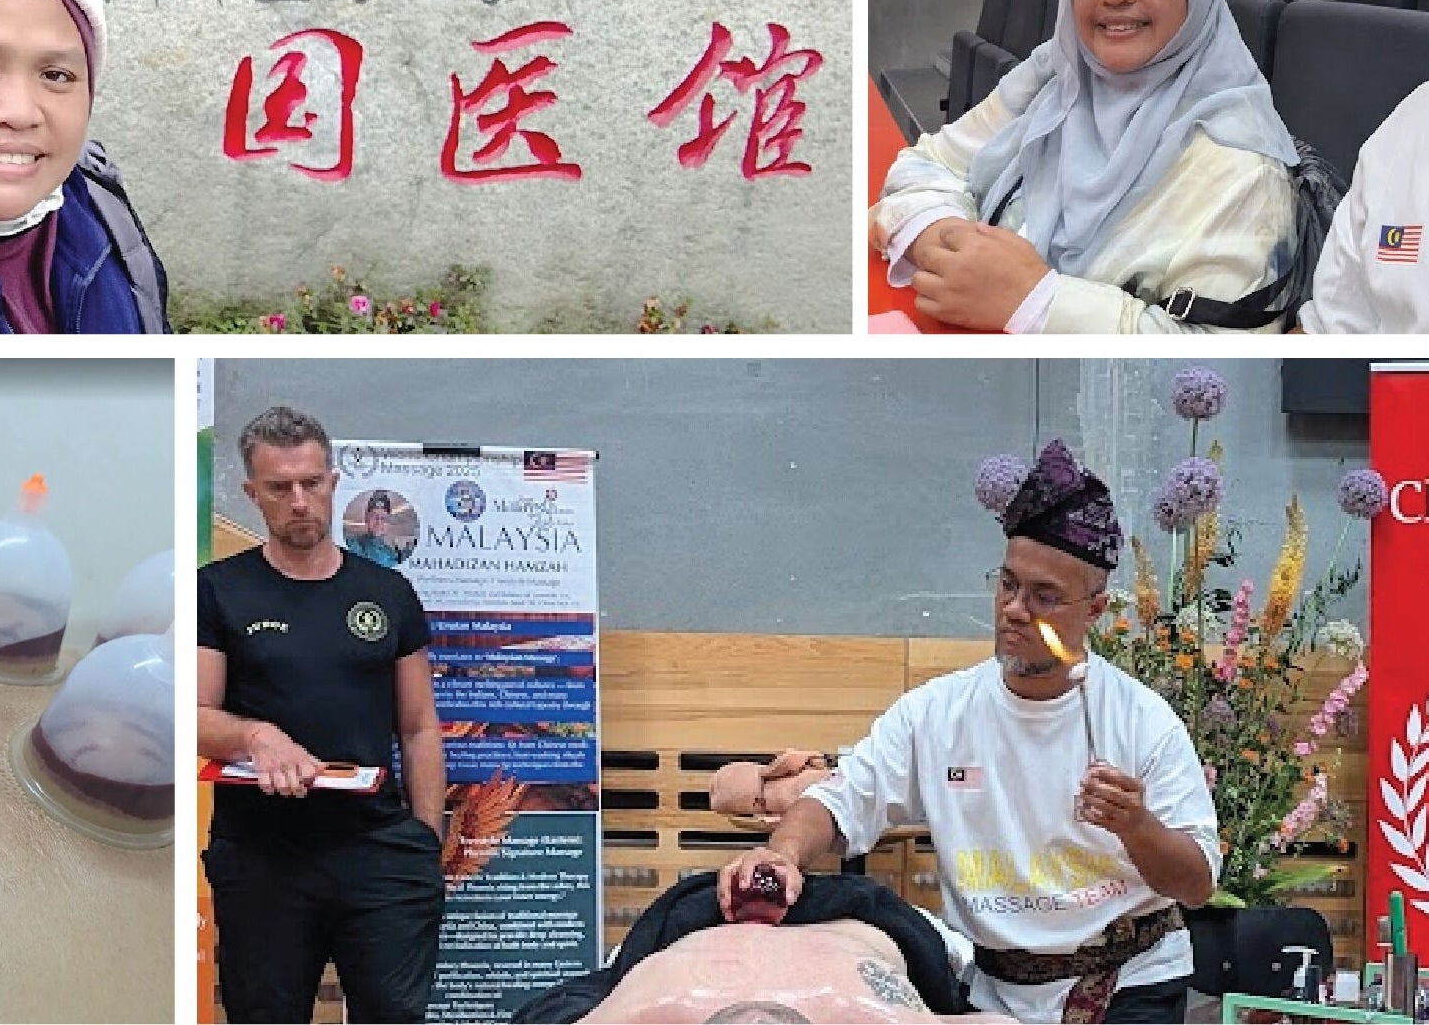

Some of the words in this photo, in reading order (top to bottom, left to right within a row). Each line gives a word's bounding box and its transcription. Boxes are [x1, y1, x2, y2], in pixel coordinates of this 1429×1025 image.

[222, 20, 825, 184] 国医馆
[426, 525, 582, 553] MALAYSIA
[960, 894, 1068, 914] MASSAGE
